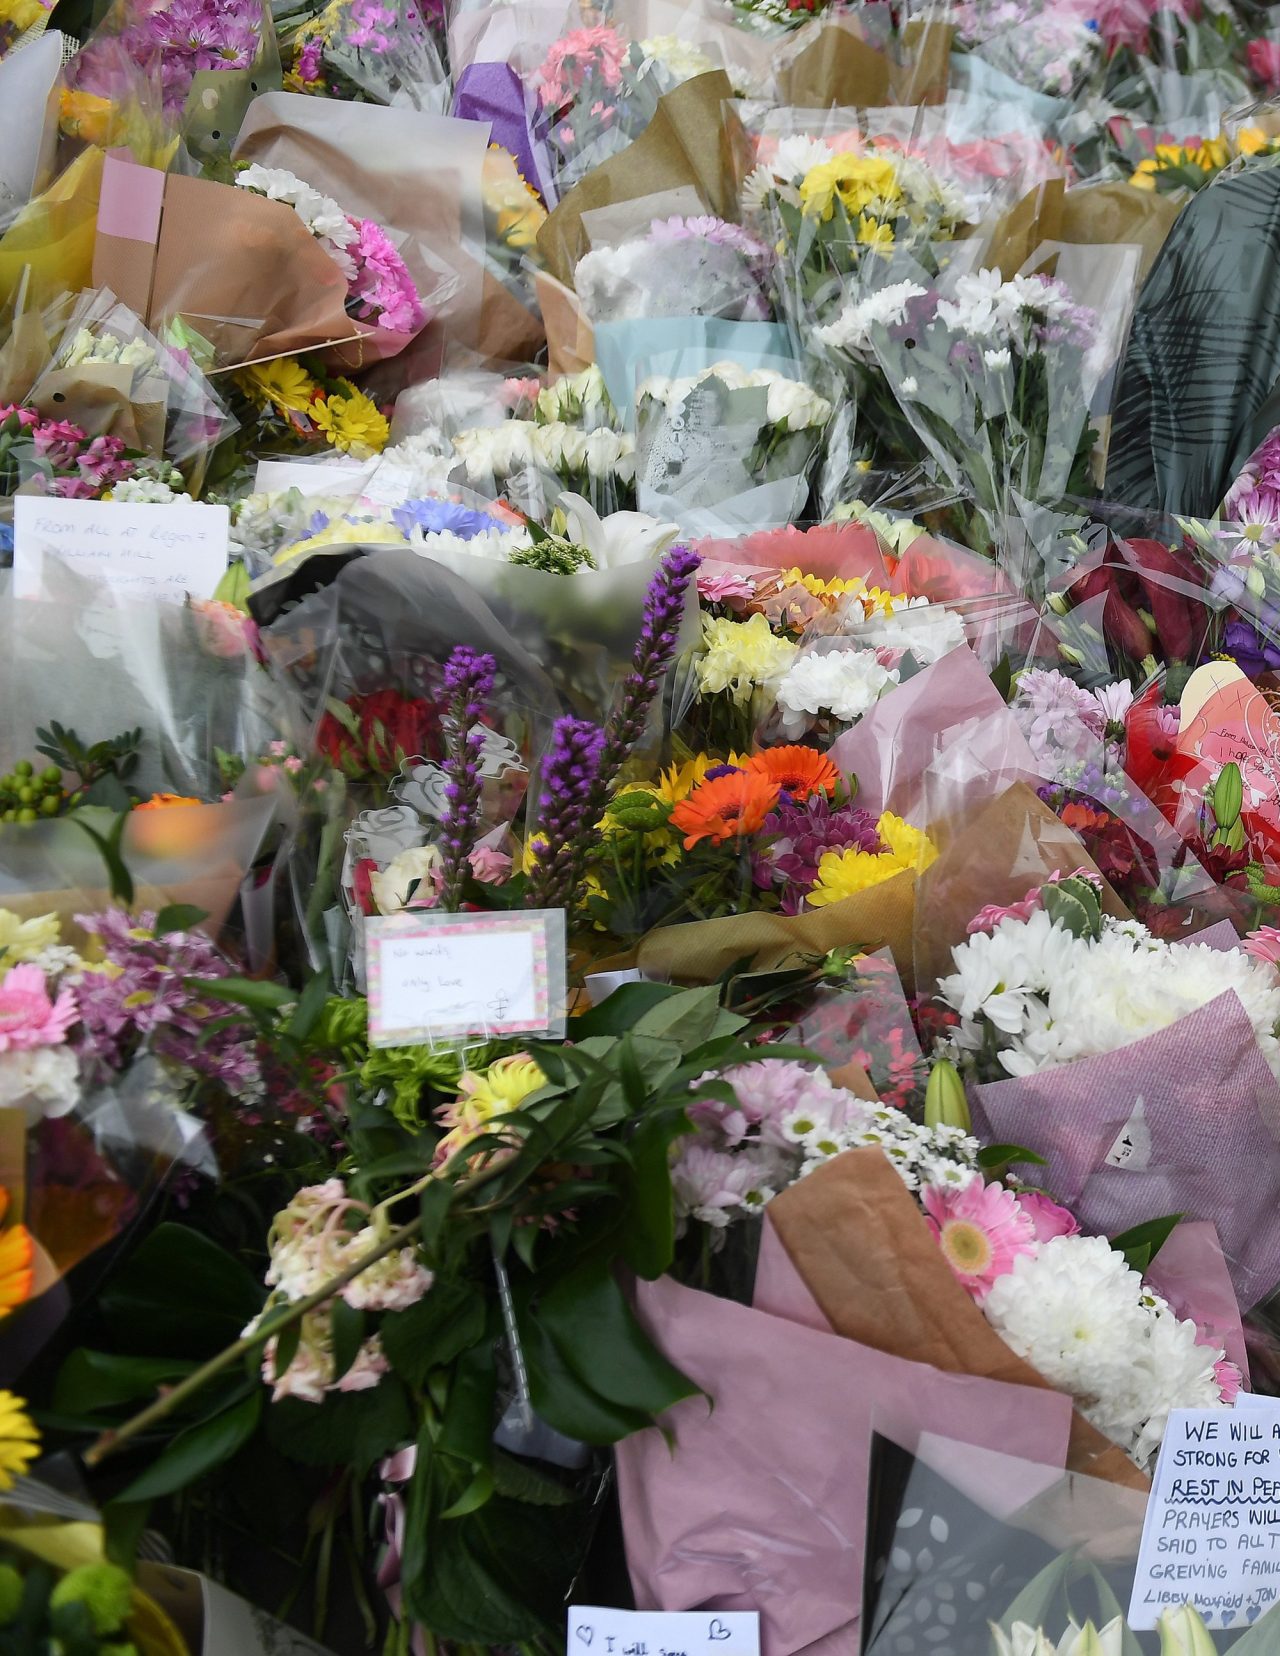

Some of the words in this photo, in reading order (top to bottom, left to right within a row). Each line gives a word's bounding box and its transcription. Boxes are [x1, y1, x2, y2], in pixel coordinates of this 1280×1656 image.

[1185, 1421, 1219, 1443] WE
[1230, 1422, 1263, 1442] WILL
[1173, 1449, 1238, 1468] STRONG
[1244, 1449, 1270, 1466] FOR
[1171, 1478, 1220, 1498] REST
[1227, 1479, 1244, 1496] IN
[1162, 1508, 1240, 1531] PRAYERS
[1157, 1536, 1197, 1555] SAID
[1206, 1537, 1228, 1551] TO
[1238, 1533, 1265, 1550] ALL
[1149, 1558, 1228, 1581] GREIVING
